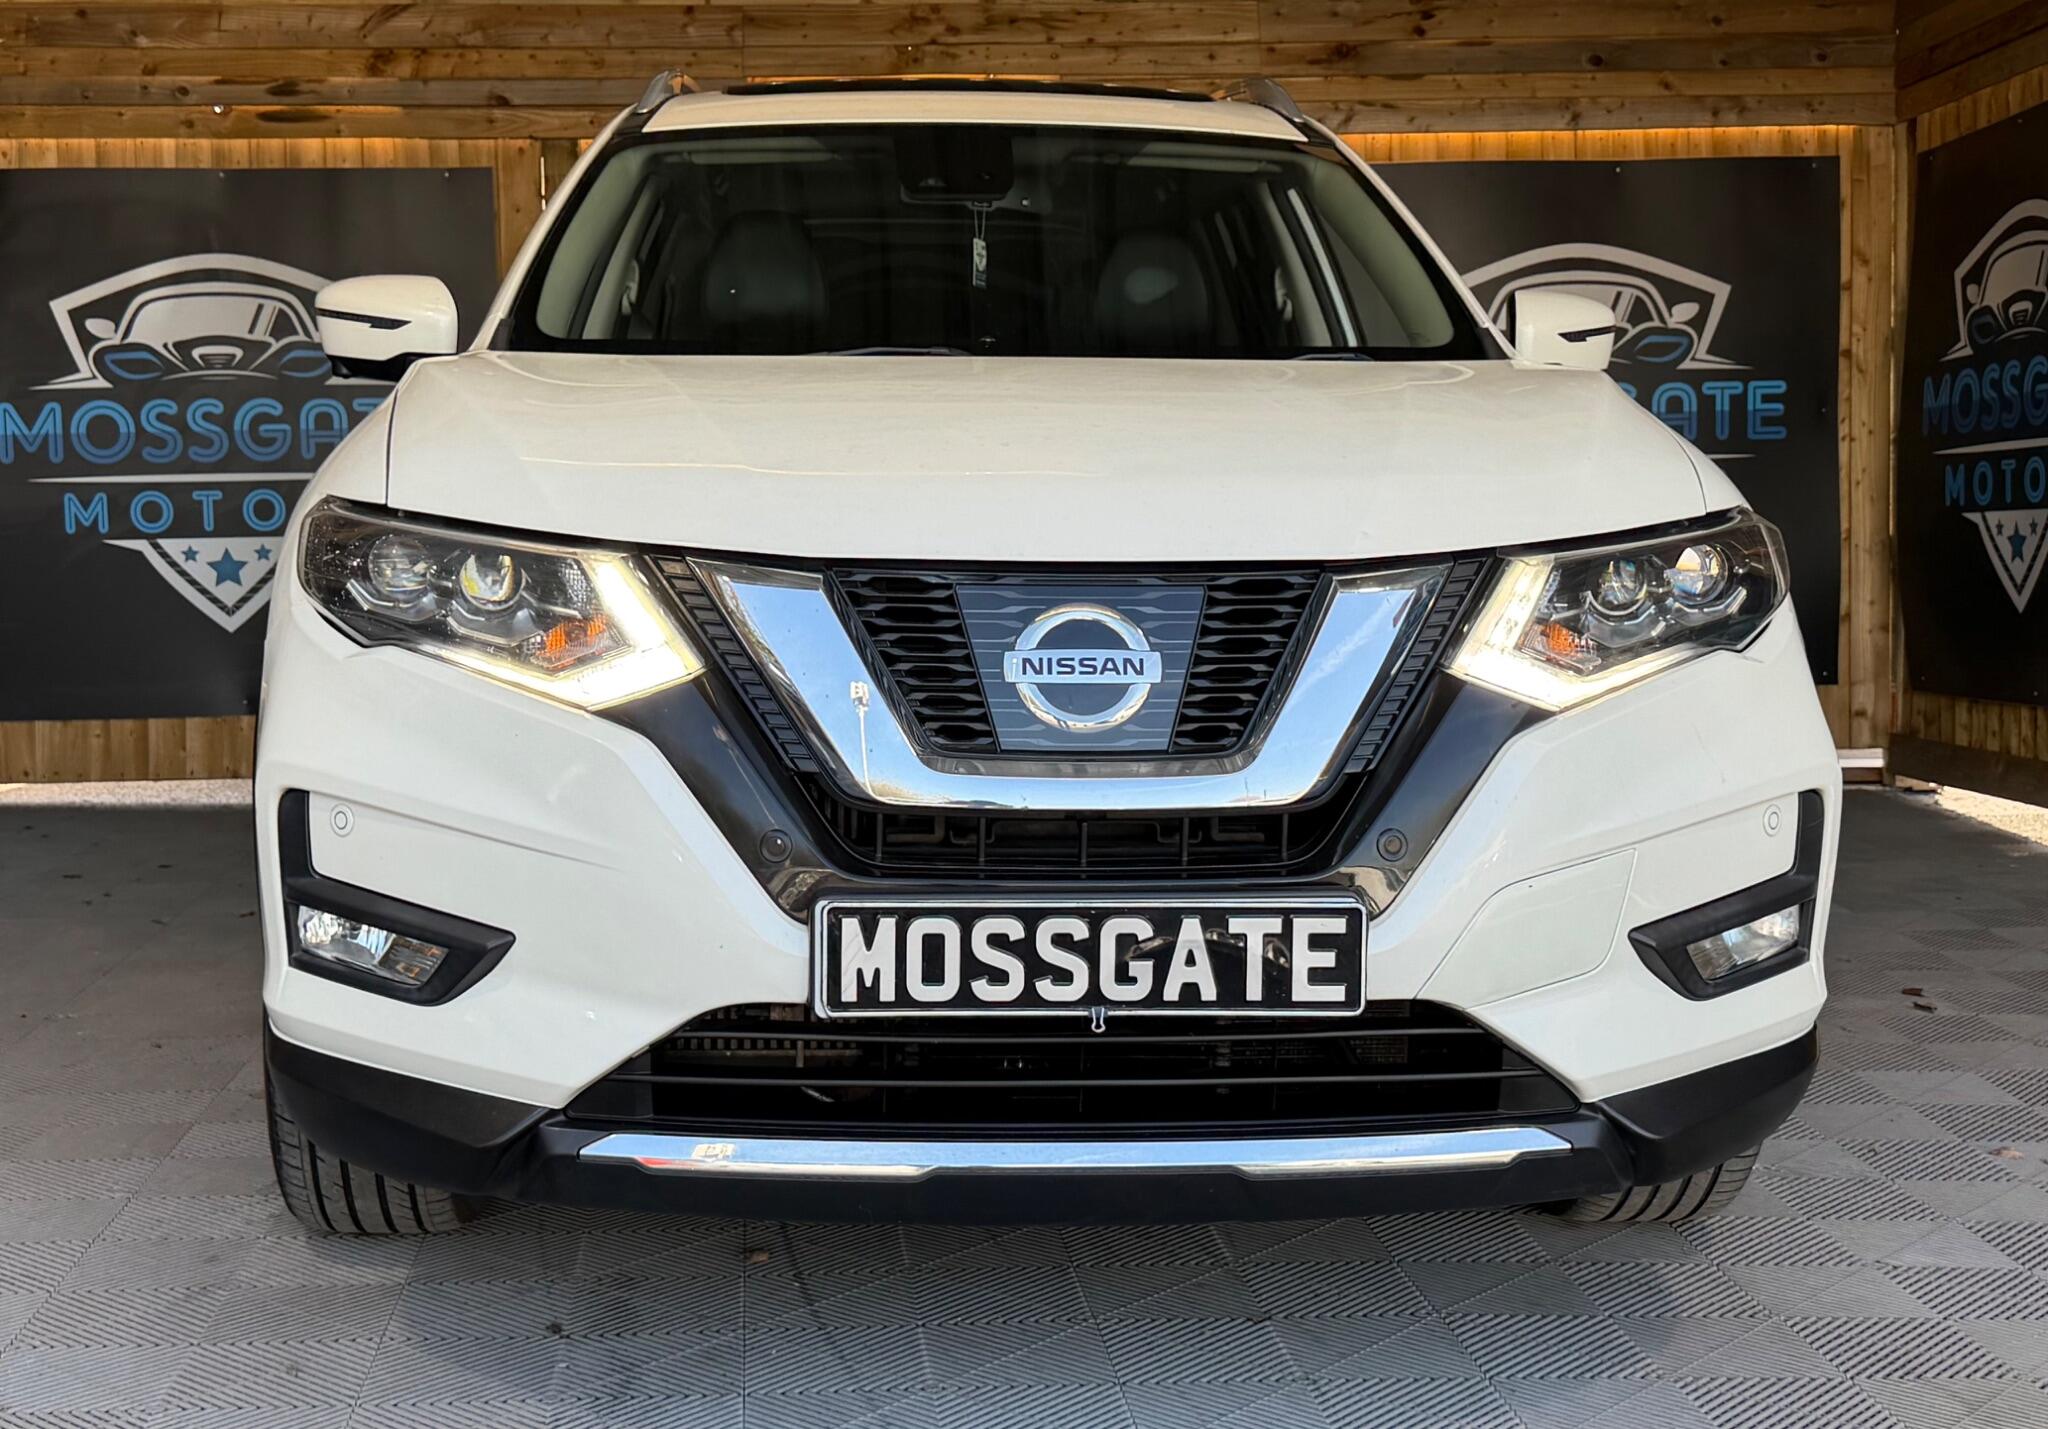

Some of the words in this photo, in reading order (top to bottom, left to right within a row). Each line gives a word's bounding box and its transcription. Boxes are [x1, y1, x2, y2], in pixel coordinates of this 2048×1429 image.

[1618, 380, 1788, 440] ATE
[1021, 656, 1145, 676] NISSAN
[839, 915, 1348, 1003] MOSSGATE
